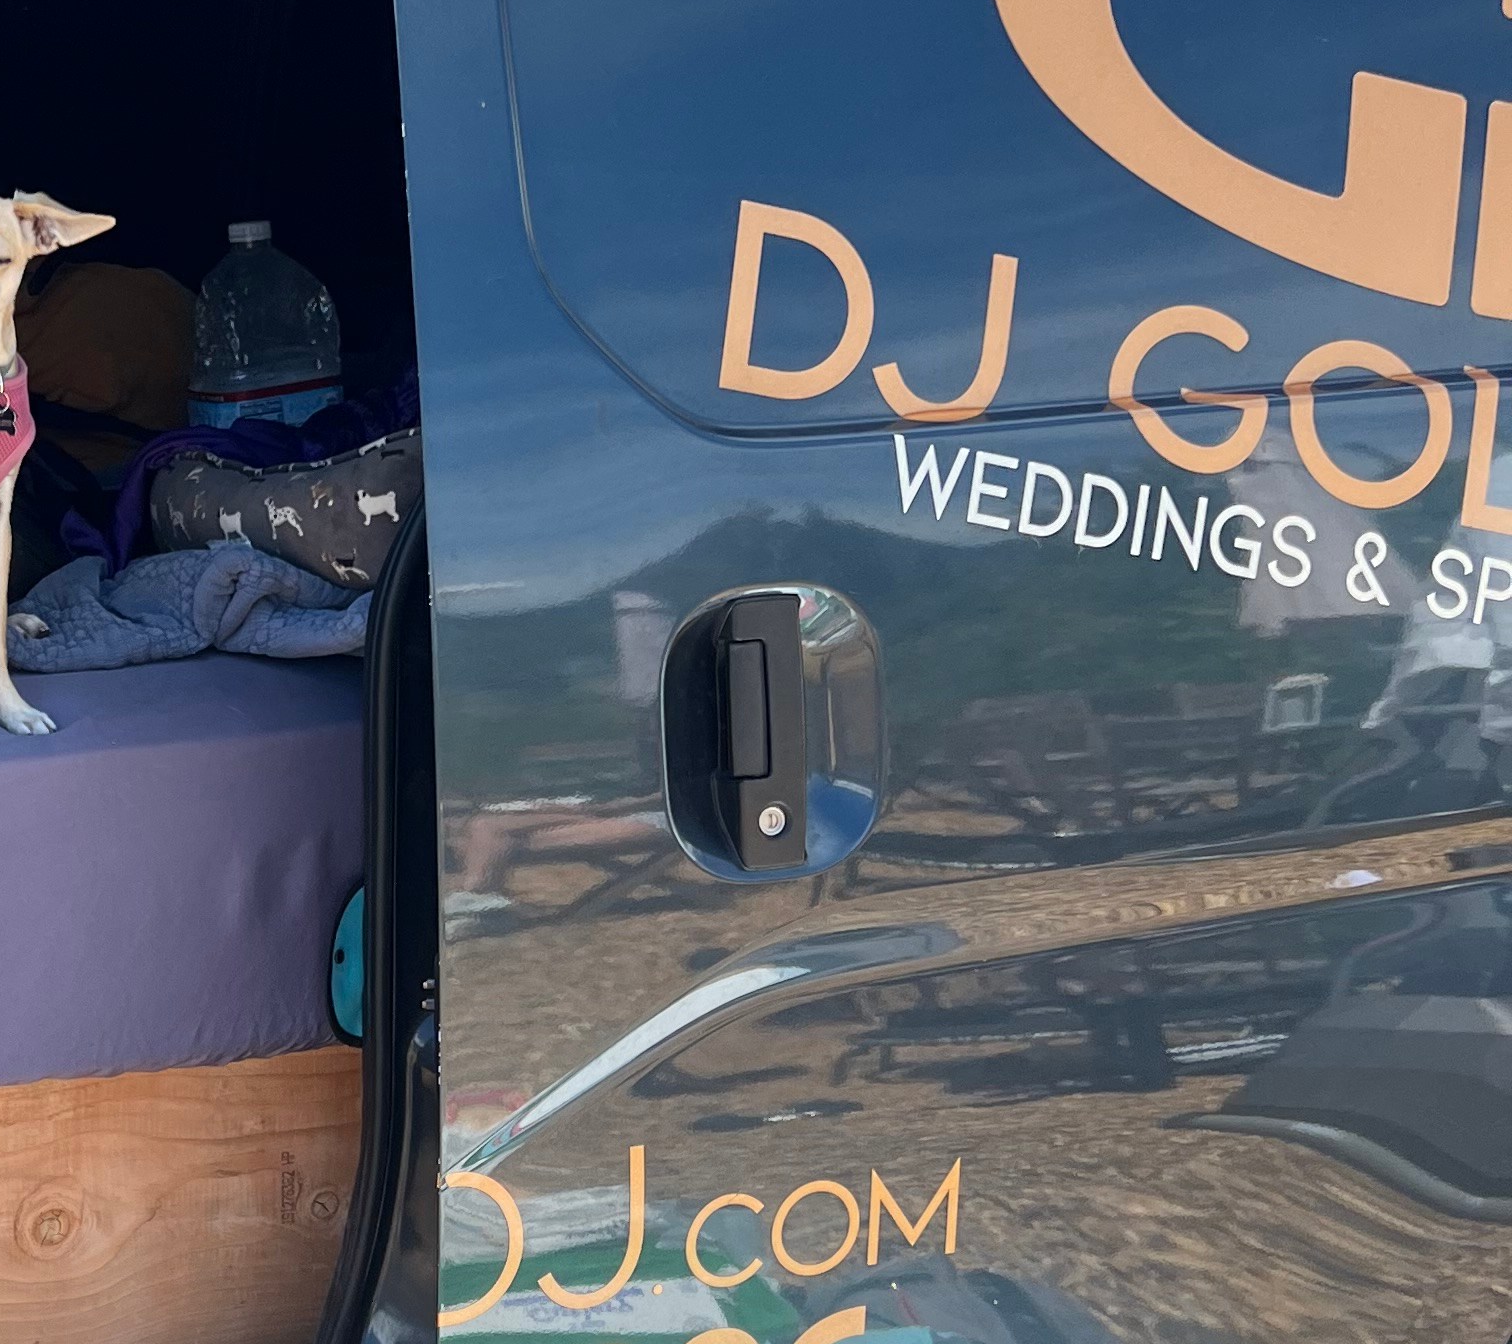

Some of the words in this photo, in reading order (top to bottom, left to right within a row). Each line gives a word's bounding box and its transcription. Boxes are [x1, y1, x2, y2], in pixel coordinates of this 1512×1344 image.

[719, 199, 1019, 423] DJ
[893, 433, 1317, 588] WEDDINGS
[1345, 531, 1391, 606] &
